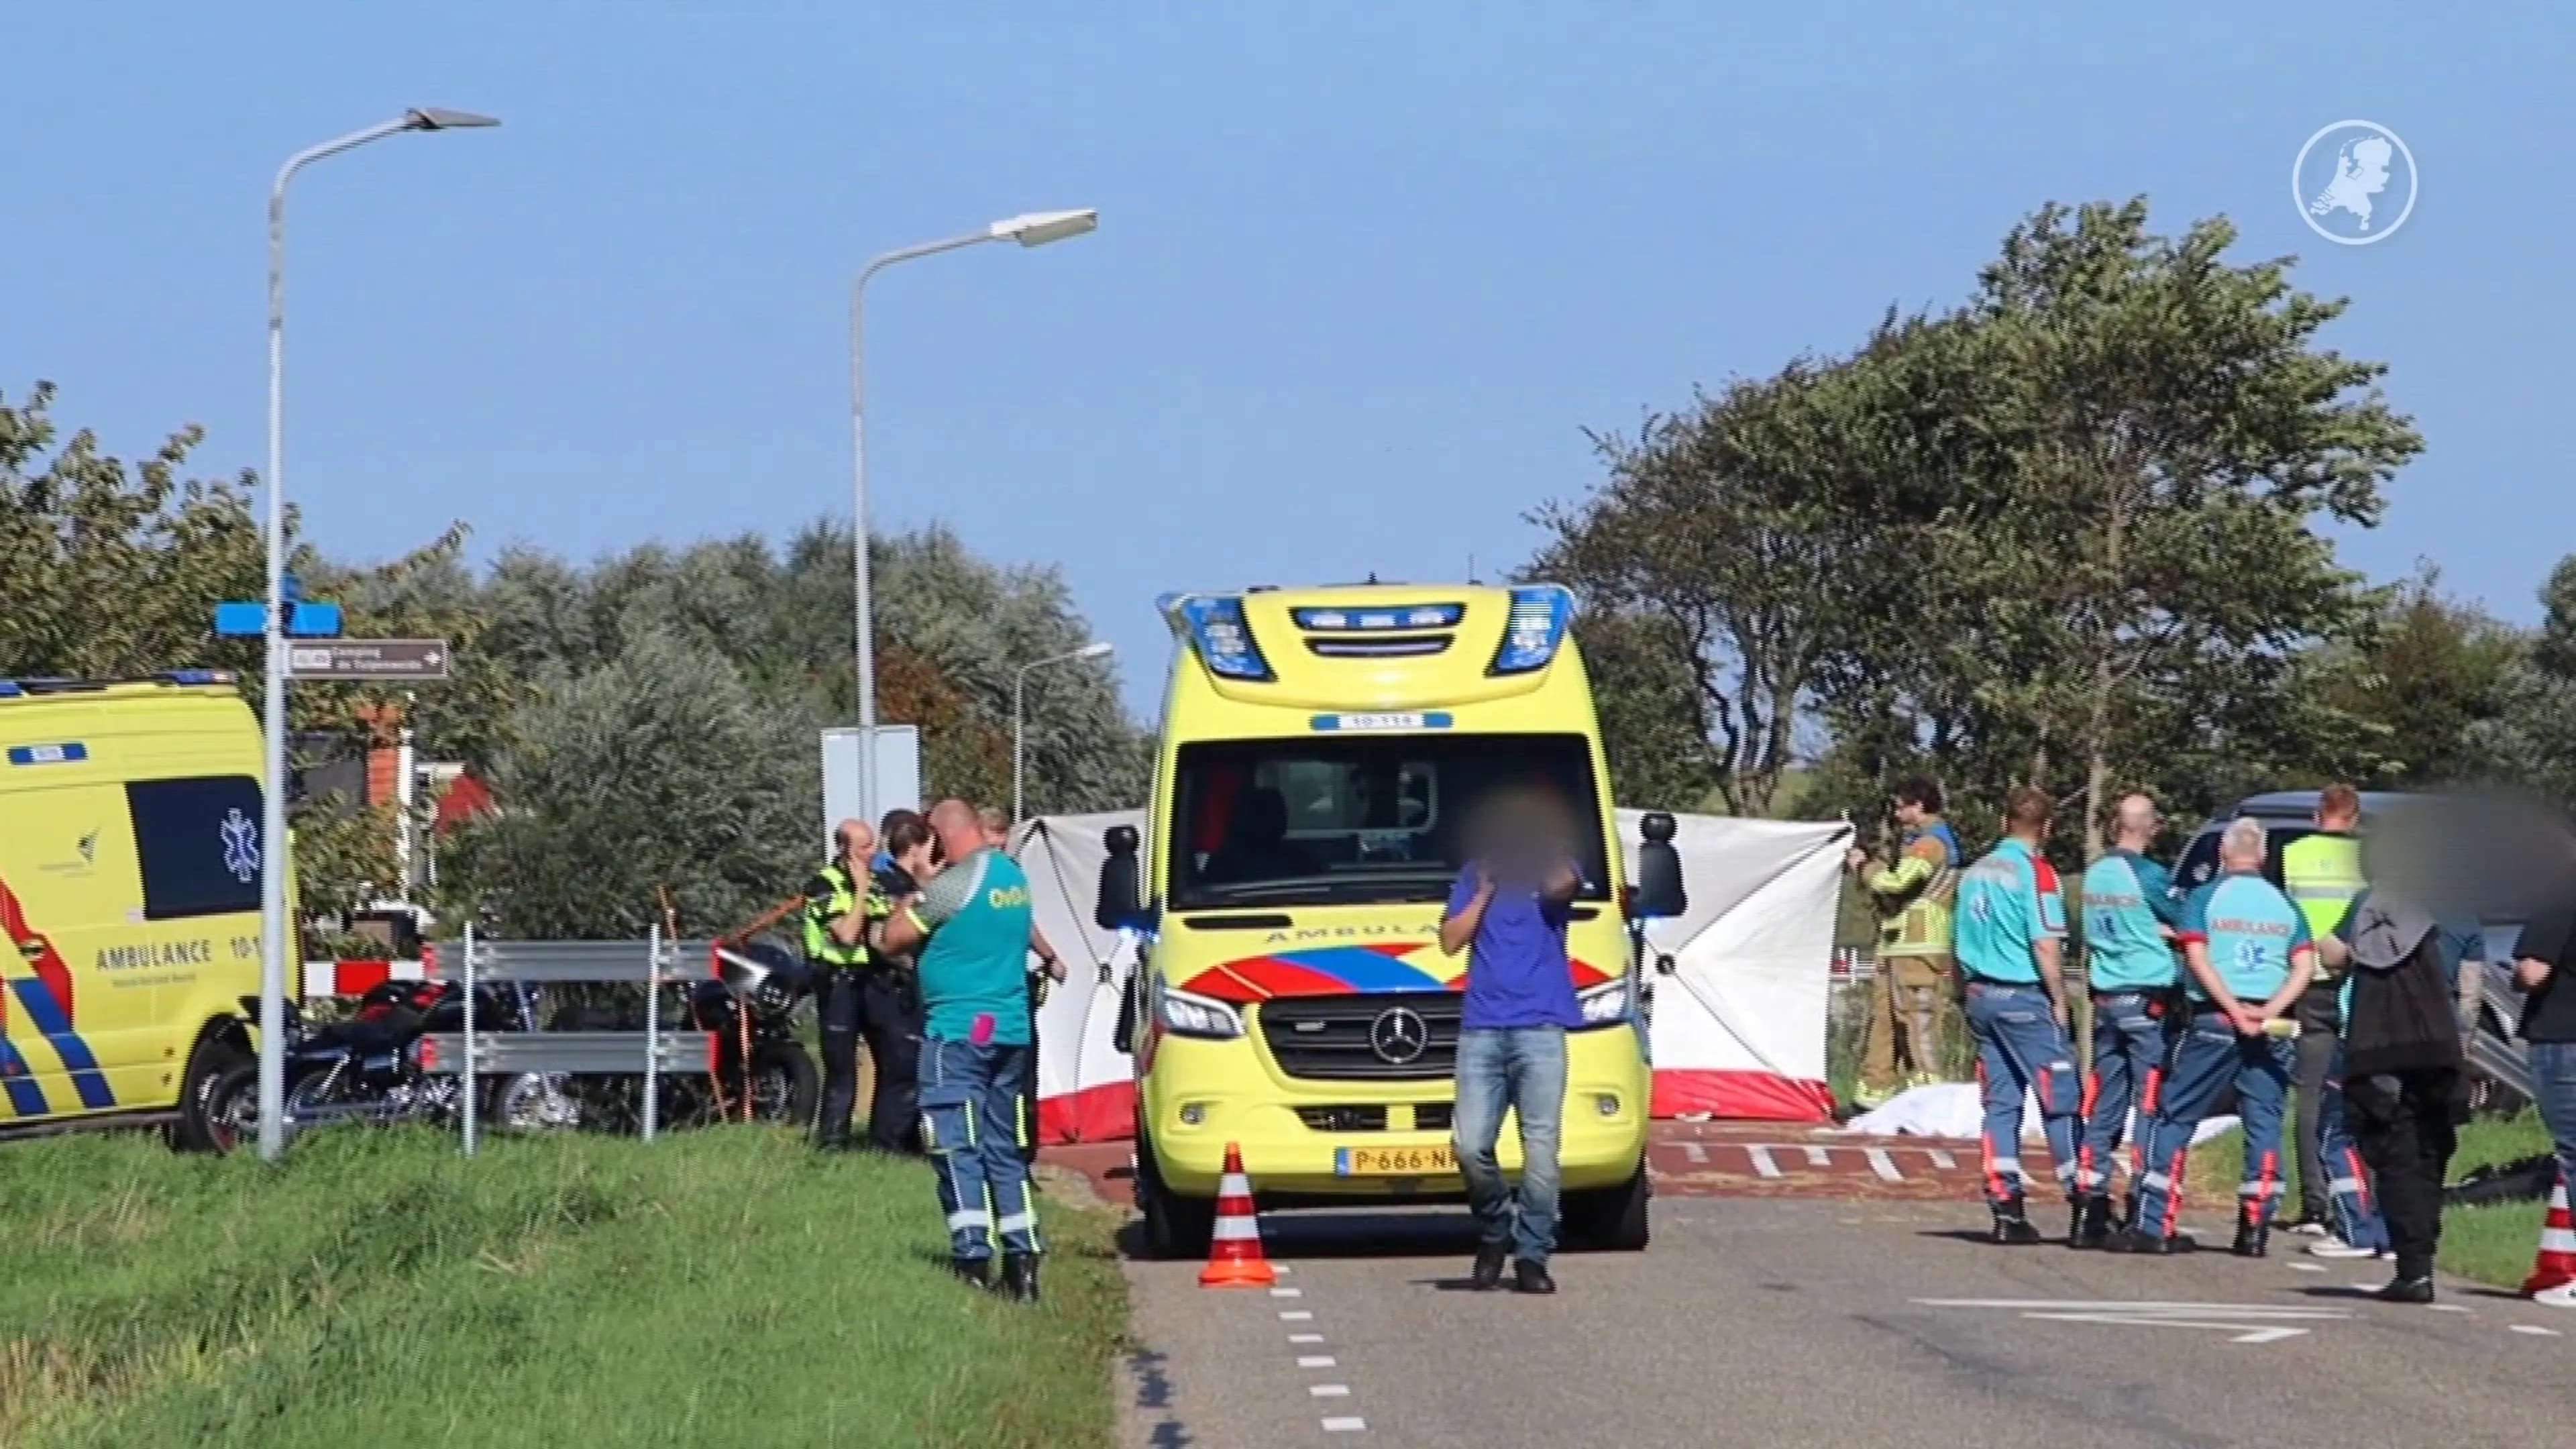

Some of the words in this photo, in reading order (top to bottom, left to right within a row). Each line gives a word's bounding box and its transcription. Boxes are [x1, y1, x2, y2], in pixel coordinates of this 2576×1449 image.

[1266, 925, 1440, 944] AMBULA
[2211, 918, 2292, 936] AMBULANCE
[96, 939, 212, 971] AMBULANCE
[229, 936, 262, 960] 10-1
